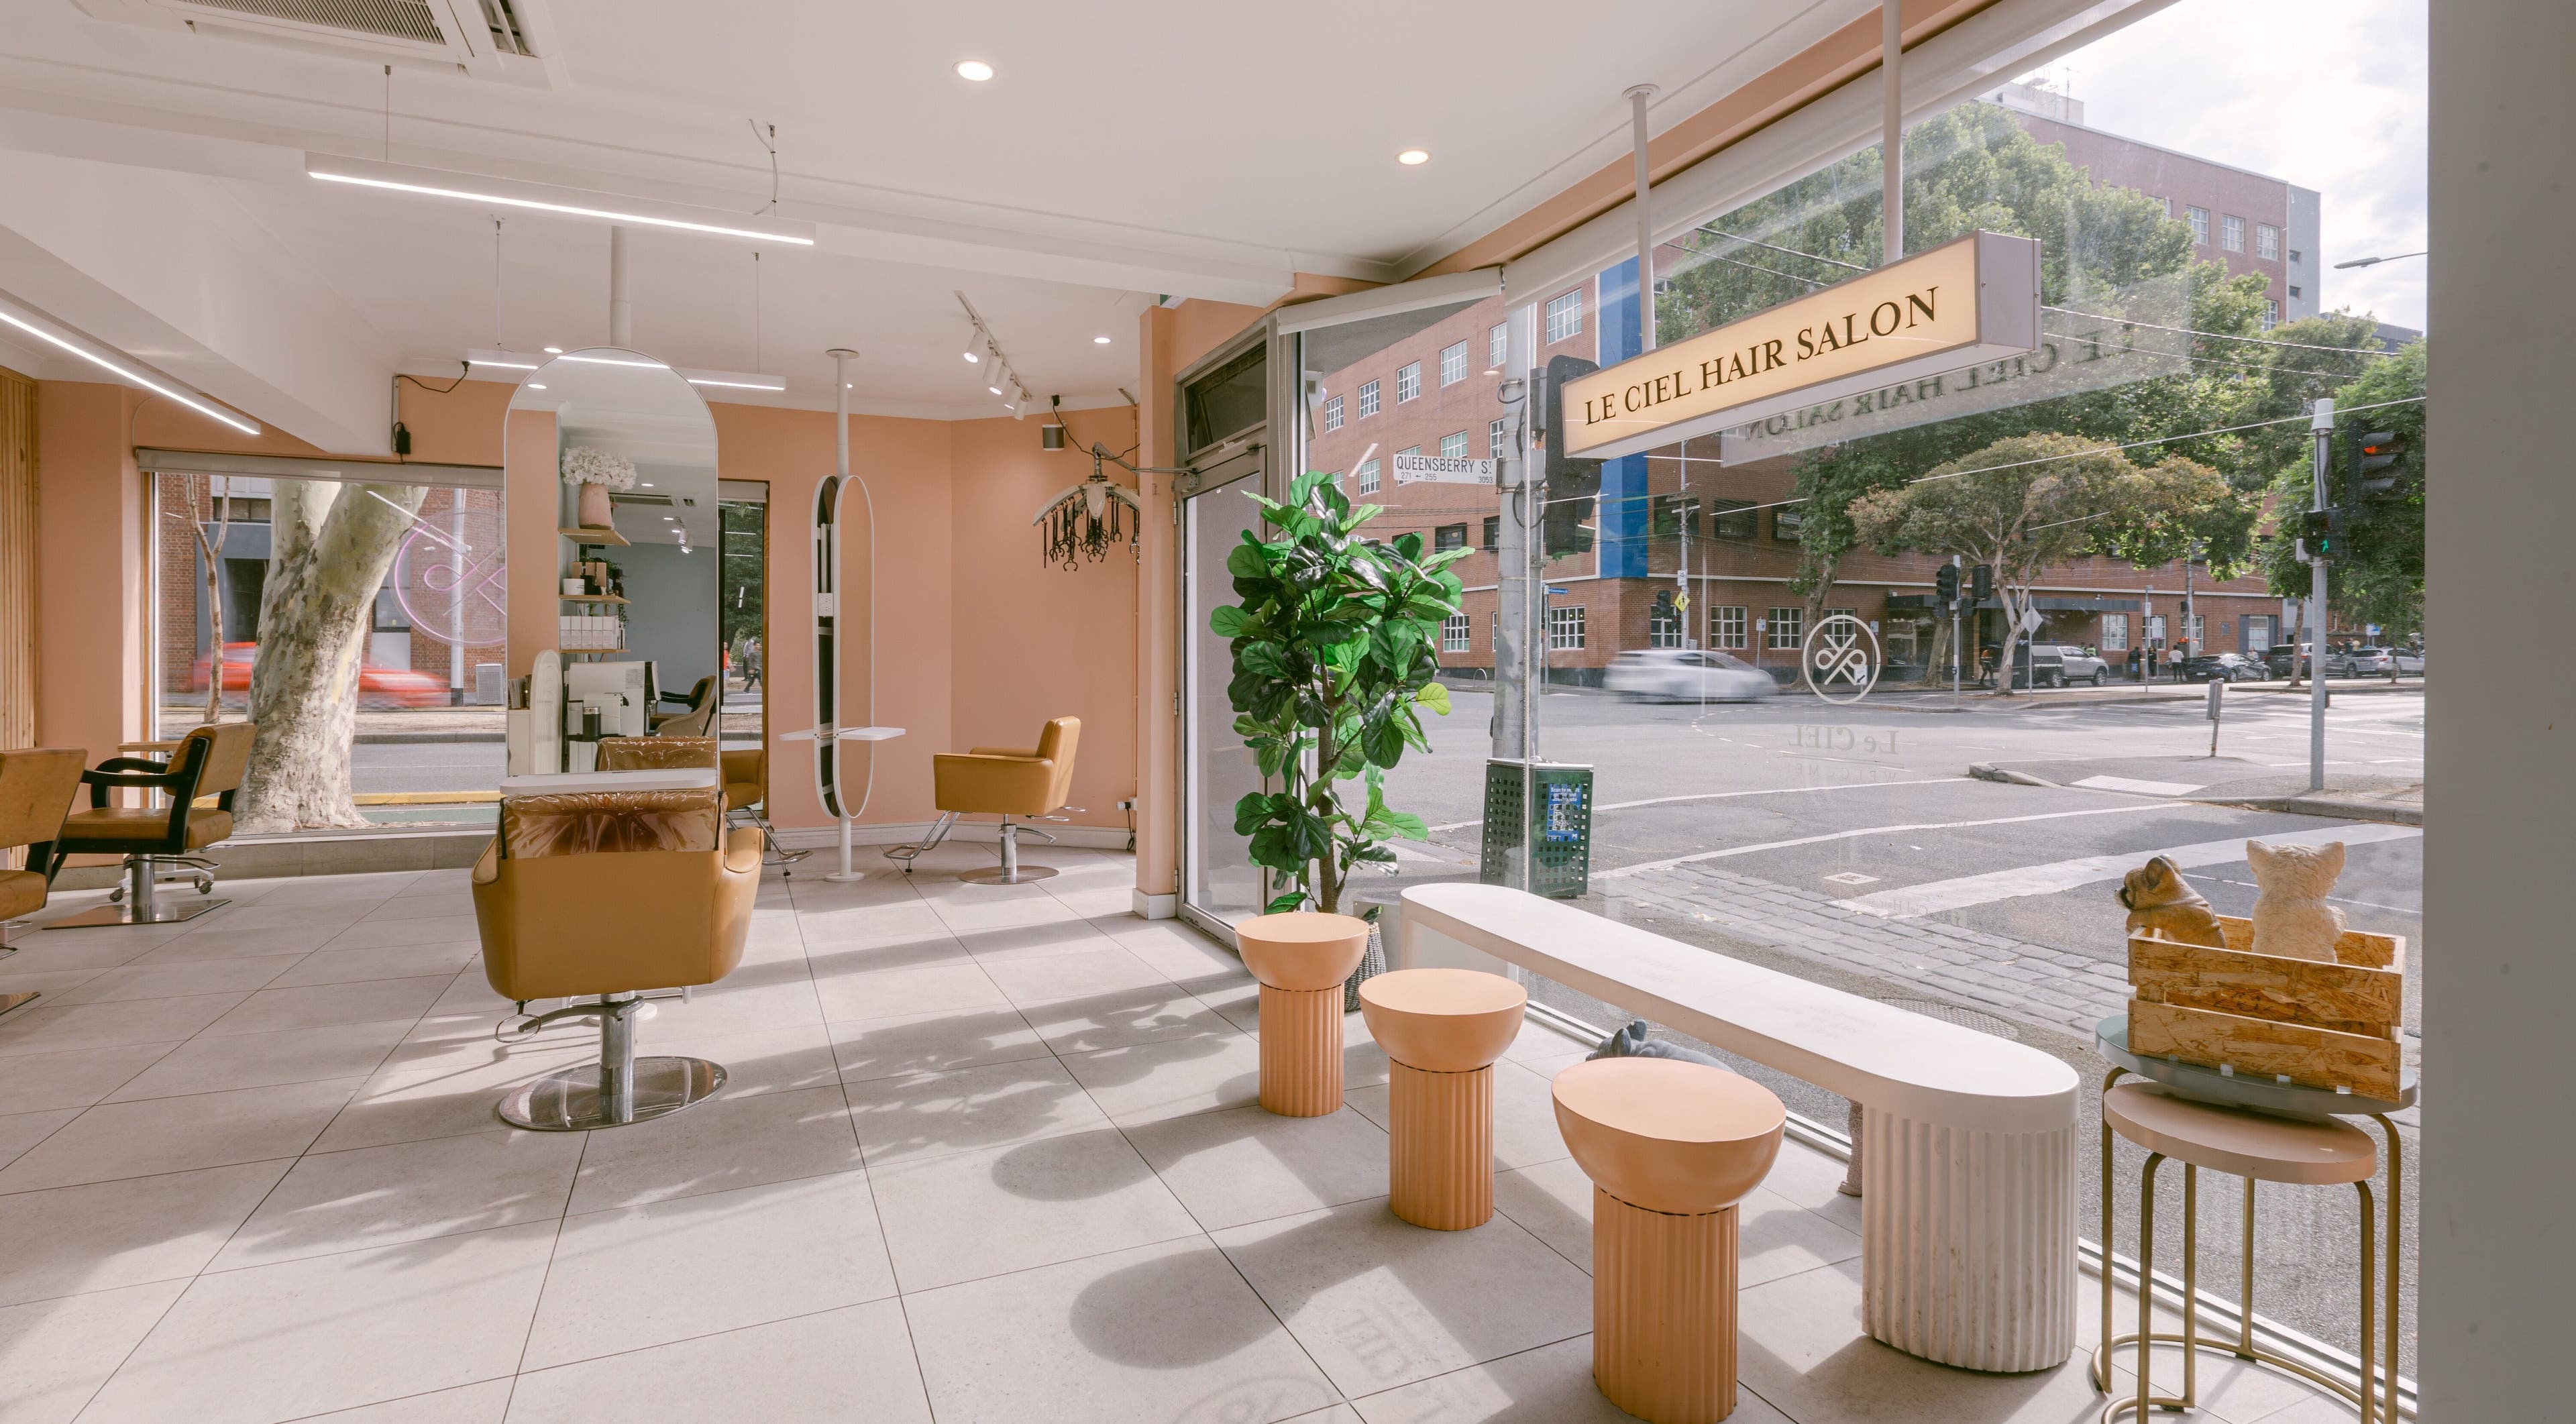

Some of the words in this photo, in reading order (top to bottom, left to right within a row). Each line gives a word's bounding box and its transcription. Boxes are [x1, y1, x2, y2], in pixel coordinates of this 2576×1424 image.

[1585, 393, 1617, 426] LE
[1624, 370, 1692, 413] CIEL
[1699, 339, 1788, 390] HAIR
[1796, 285, 1939, 362] SALON
[1397, 455, 1475, 474] QUEENSBERRY
[1401, 472, 1411, 480] 271
[1425, 473, 1437, 481] 255
